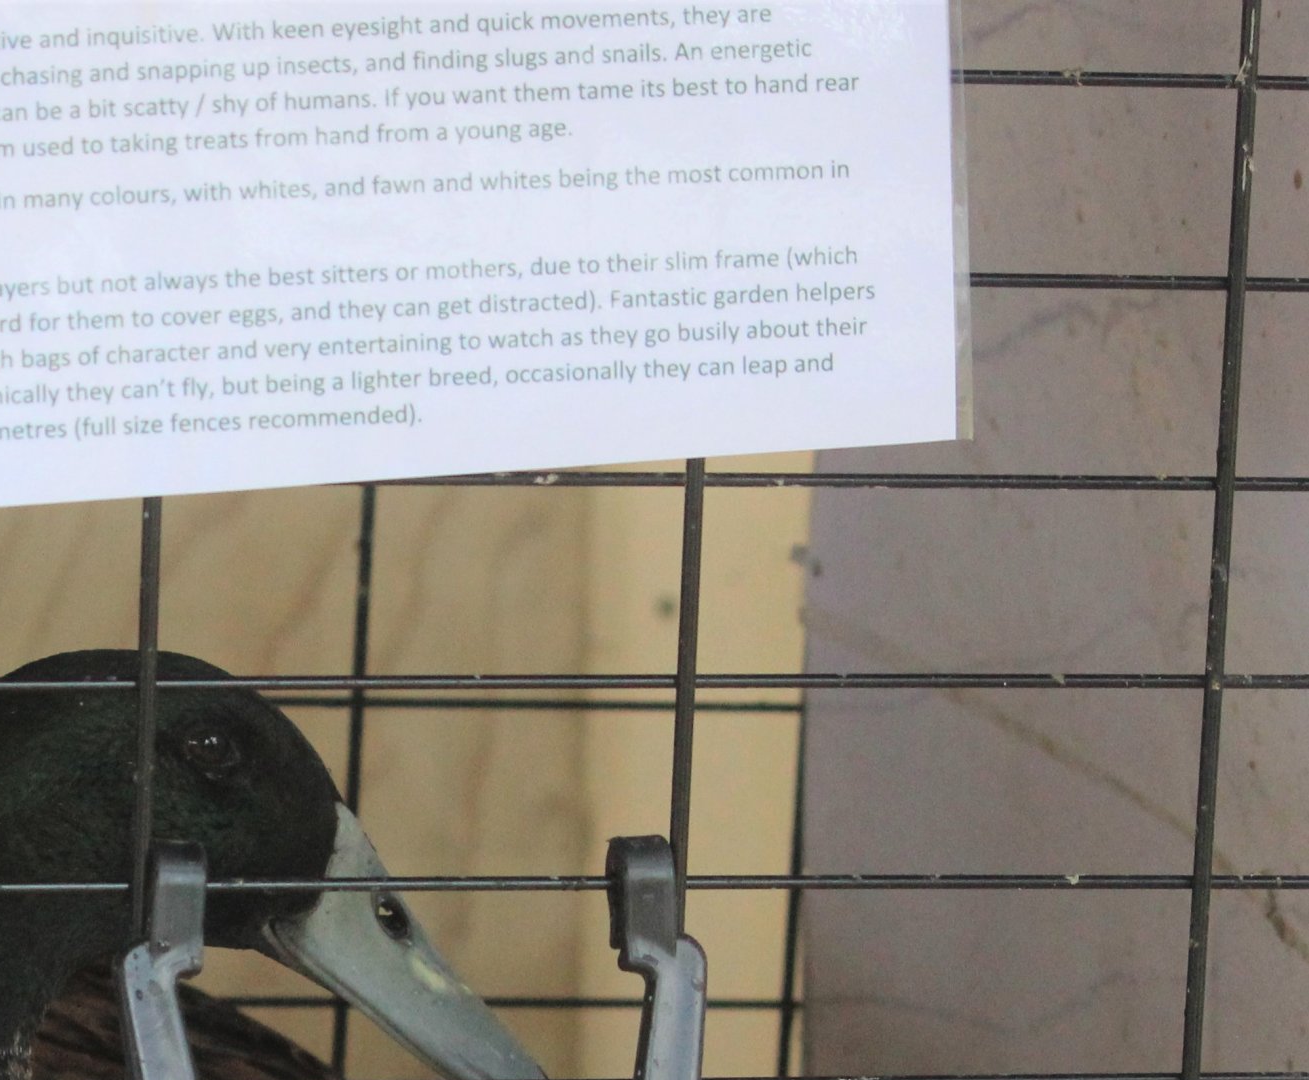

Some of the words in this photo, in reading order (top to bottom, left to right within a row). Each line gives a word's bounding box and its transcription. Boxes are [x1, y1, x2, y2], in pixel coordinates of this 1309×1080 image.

[39, 27, 80, 49] and
[87, 24, 204, 50] inquisitive.
[212, 20, 265, 42] With
[272, 19, 324, 40] keen
[331, 14, 423, 42] eyesight
[429, 13, 469, 35] and
[477, 10, 534, 37] quick
[541, 8, 675, 30] movements,
[682, 5, 731, 29] they
[737, 7, 772, 24] are
[0, 65, 83, 88] chasing
[89, 61, 129, 84] and
[137, 62, 235, 84] snapping
[242, 61, 270, 81] up
[277, 56, 358, 76] insects,
[366, 50, 406, 73] and
[412, 49, 488, 74] finding
[495, 47, 548, 72] slugs
[554, 44, 594, 66] and
[602, 41, 667, 65] snails.
[674, 41, 703, 61] An
[710, 38, 812, 64] energetic
[36, 101, 62, 121] be
[69, 104, 81, 120] a
[88, 98, 116, 119] bit
[123, 97, 189, 120] scatty
[195, 93, 205, 118] /
[212, 93, 249, 118] shy
[255, 90, 277, 113] of
[284, 91, 376, 112] humans.
[385, 86, 400, 108] If
[406, 90, 445, 111] you
[452, 86, 507, 105] want
[513, 82, 571, 103] them
[577, 82, 634, 101] tame
[641, 79, 666, 99] its
[672, 77, 718, 98] best
[725, 77, 748, 96] to
[754, 72, 808, 95] hand
[816, 76, 859, 93] rear
[23, 135, 74, 158] used
[81, 137, 104, 155] to
[110, 133, 178, 157] taking
[184, 132, 248, 151] treats
[255, 128, 308, 148] from
[315, 124, 369, 146] hand
[376, 122, 429, 143] from
[436, 125, 448, 141] a
[455, 123, 522, 145] young
[528, 122, 572, 143] age.
[24, 192, 83, 211] many
[90, 184, 176, 207] colours,
[183, 182, 231, 203] with
[239, 179, 317, 201] whites,
[325, 175, 365, 198] and
[371, 174, 425, 195] fawn
[433, 171, 472, 193] and
[480, 170, 552, 191] whites
[559, 167, 619, 192] being
[625, 165, 660, 186] the
[668, 165, 721, 185] most
[728, 164, 823, 183] common
[831, 159, 849, 179] in
[57, 276, 93, 296] but
[101, 274, 137, 293] not
[144, 271, 218, 294] always
[224, 267, 261, 288] the
[268, 266, 314, 287] best
[321, 265, 389, 285] sitters
[395, 266, 418, 282] or
[426, 258, 523, 280] mothers,
[530, 255, 571, 276] due
[577, 257, 600, 275] to
[606, 252, 658, 274] their
[665, 250, 708, 272] slim
[715, 249, 779, 270] frame
[787, 245, 857, 271] (which
[29, 311, 60, 332] for
[67, 310, 124, 331] them
[131, 310, 154, 328] to
[161, 310, 222, 327] cover
[228, 307, 283, 329] eggs,
[291, 300, 331, 322] and
[338, 299, 387, 323] they
[393, 301, 430, 318] can
[437, 297, 472, 321] get
[478, 289, 602, 314] distracted).
[610, 286, 707, 309] Fantastic
[713, 283, 788, 311] garden
[796, 281, 875, 306] helpers
[21, 348, 71, 373] bags
[78, 344, 100, 367] of
[106, 344, 210, 365] character
[217, 339, 257, 361] and
[264, 341, 311, 362] very
[318, 333, 452, 357] entertaining
[458, 332, 481, 351] to
[488, 327, 553, 350] watch
[560, 331, 583, 348] as
[590, 324, 638, 349] they
[644, 327, 670, 349] go
[678, 320, 740, 345] busily
[746, 318, 809, 340] about
[816, 316, 867, 337] their
[66, 382, 114, 405] they
[182, 376, 214, 401] fly,
[222, 375, 259, 396] but
[266, 373, 326, 397] being
[332, 376, 344, 392] a
[351, 369, 422, 395] lighter
[428, 365, 498, 388] breed,
[505, 360, 637, 385] occasionally
[643, 359, 691, 382] they
[697, 360, 735, 378] can
[743, 355, 787, 379] leap
[794, 352, 834, 374] and
[74, 416, 116, 441] (full
[123, 415, 163, 435] size
[170, 412, 242, 433] fences
[249, 402, 422, 431] recommended).
